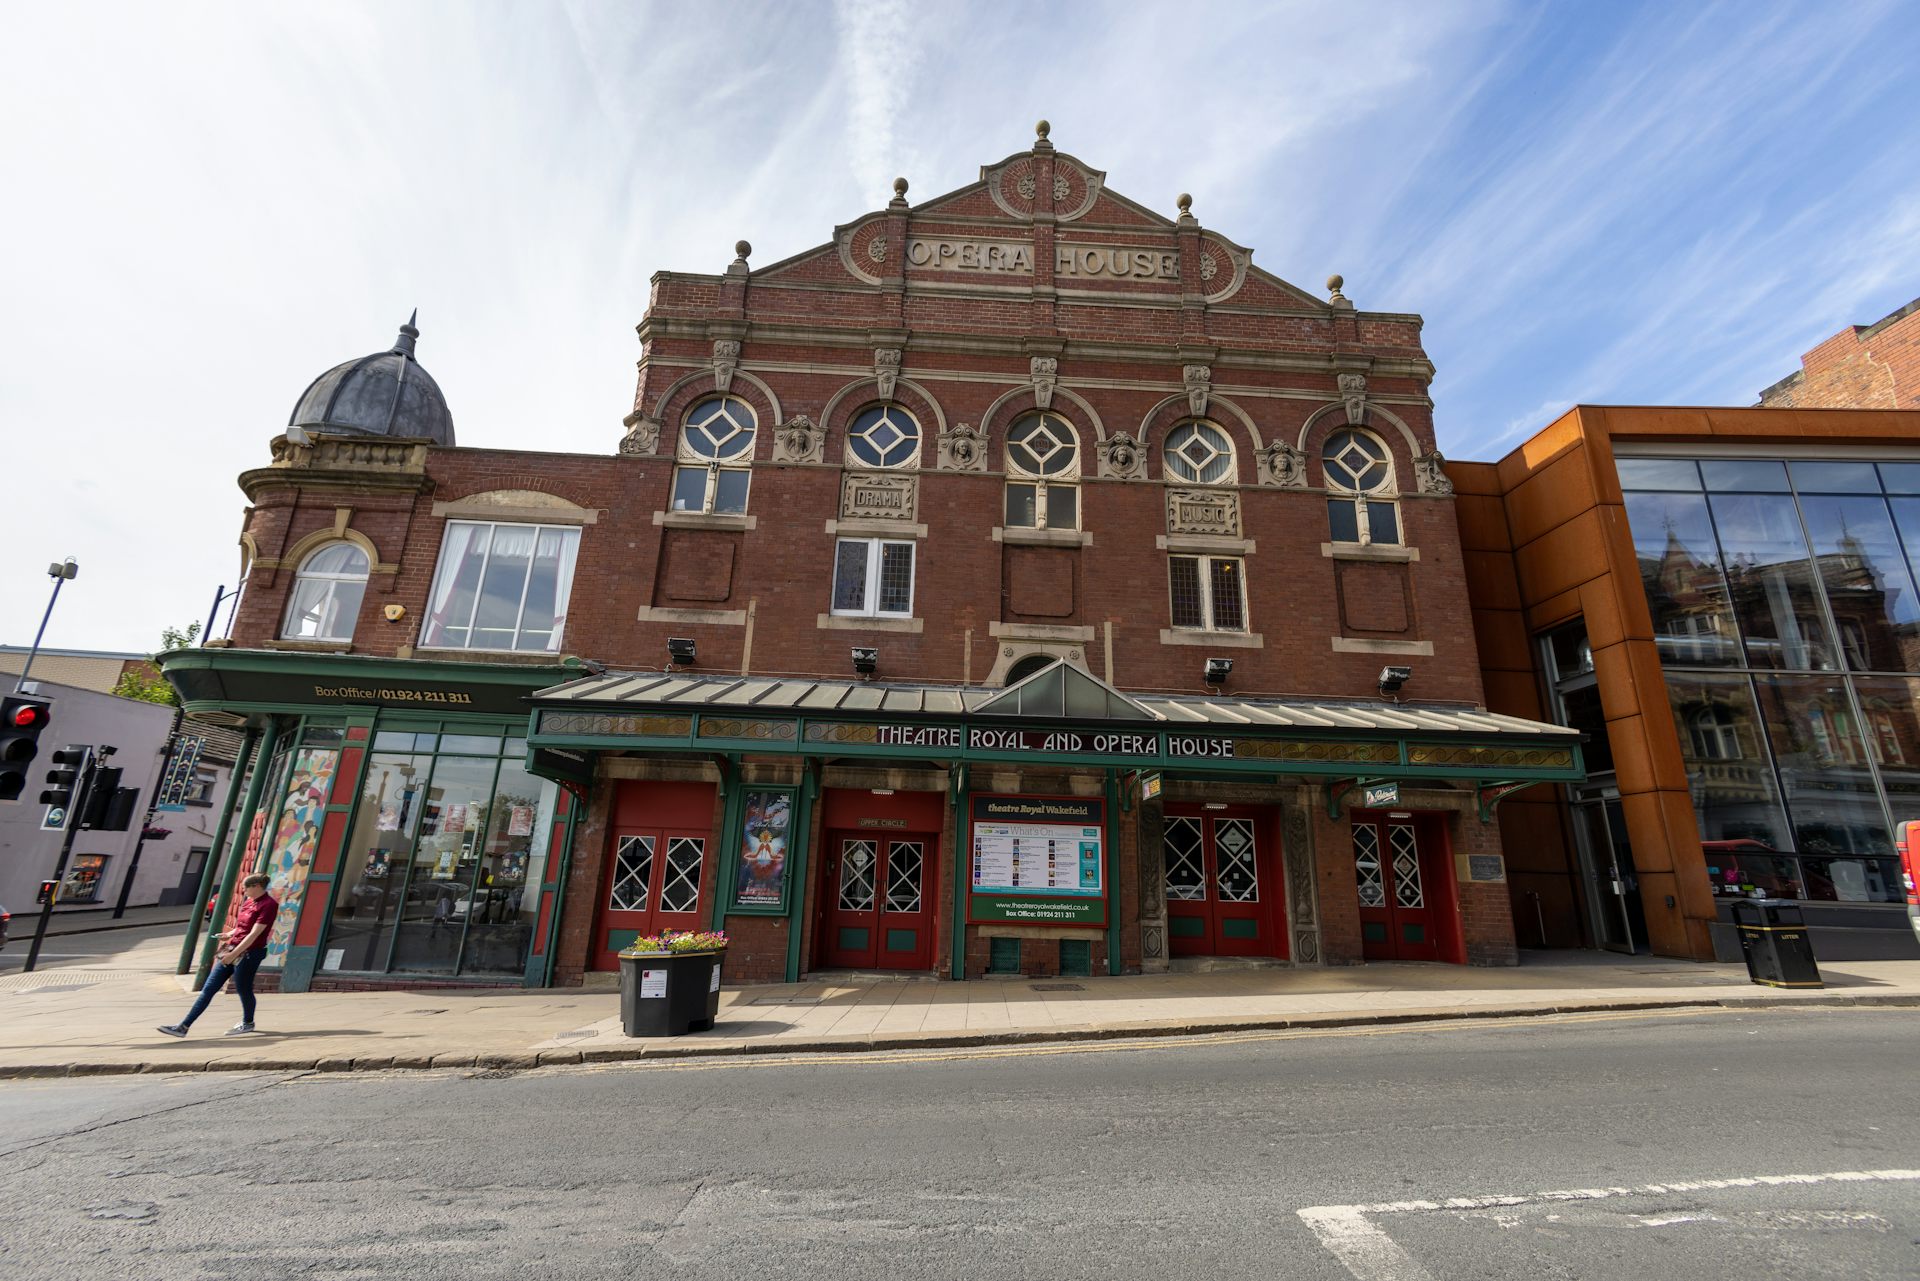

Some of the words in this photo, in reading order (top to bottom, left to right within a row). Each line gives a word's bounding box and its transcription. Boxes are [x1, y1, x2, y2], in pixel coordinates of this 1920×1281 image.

[906, 239, 1033, 272] OPERA
[1054, 246, 1179, 279] HOUSE
[856, 490, 902, 508] DRAMA
[1181, 505, 1225, 524] MUSIC
[315, 686, 339, 698] Box
[424, 691, 448, 703] 211
[449, 692, 473, 704] 311
[878, 725, 961, 747] THEATRE
[970, 729, 1032, 750] ROYAL
[1043, 732, 1083, 751] AND
[1093, 734, 1157, 755] OPERA
[1168, 736, 1233, 758] HOUSE
[988, 803, 1019, 813] theatre
[1020, 804, 1045, 816] Royal
[1046, 805, 1089, 816] Wakefield
[1010, 825, 1039, 836] What's
[1040, 826, 1054, 837] On
